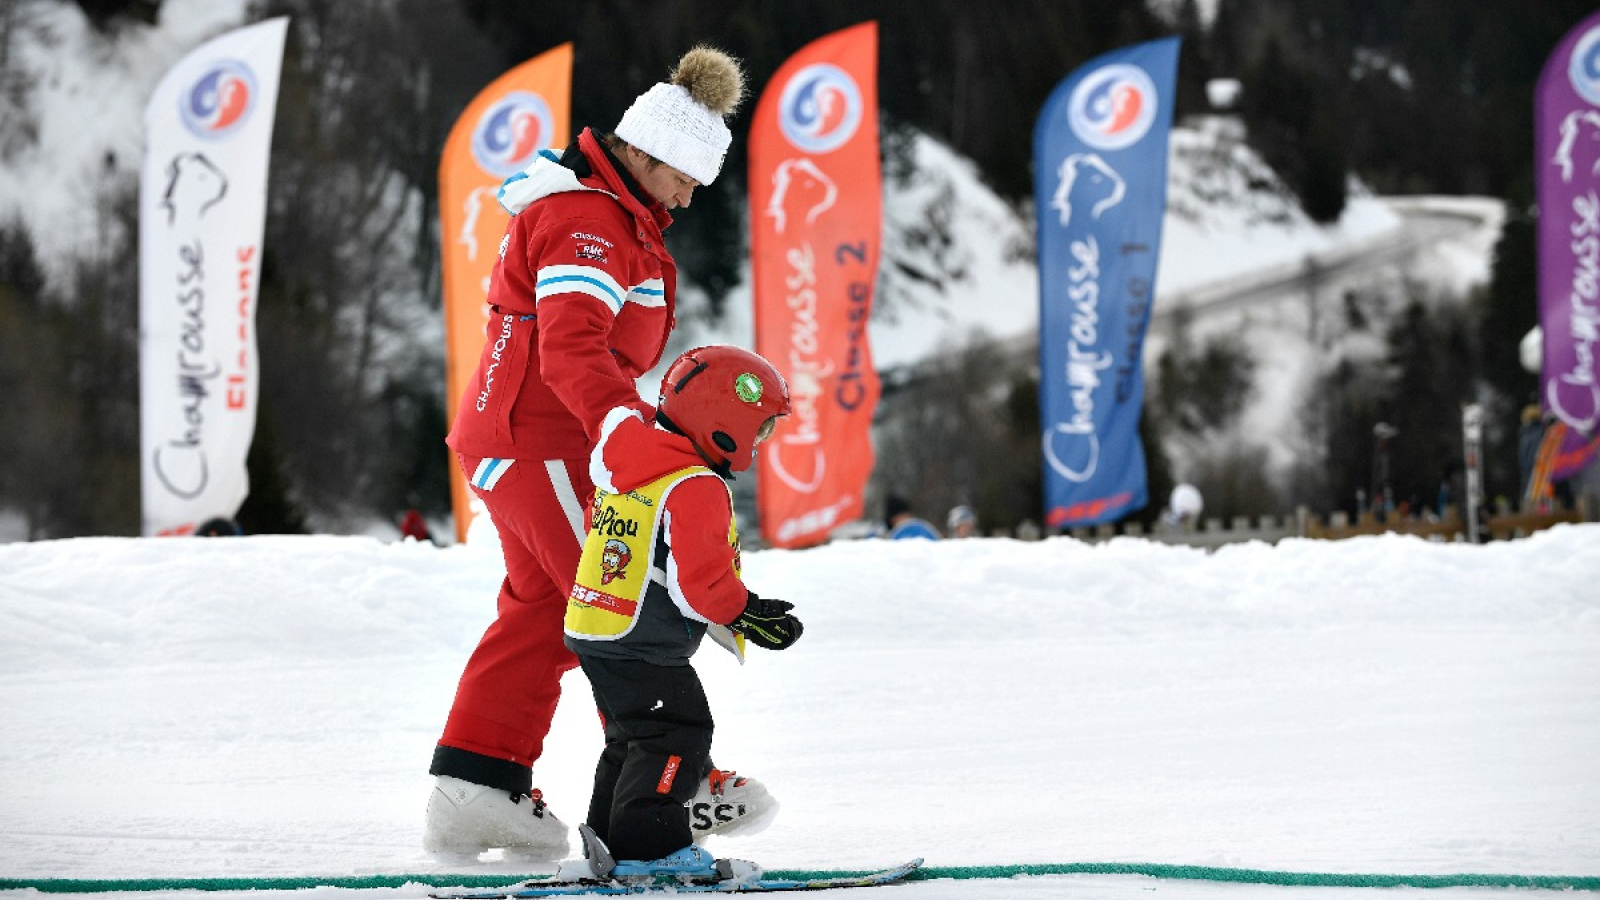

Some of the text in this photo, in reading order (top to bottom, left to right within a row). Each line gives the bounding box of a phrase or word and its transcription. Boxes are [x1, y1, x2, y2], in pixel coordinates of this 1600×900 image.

[153, 238, 221, 500] Chamrousse
[768, 240, 835, 494] Chamrousse
[835, 240, 868, 265] 2
[1043, 233, 1112, 483] Chamrousse
